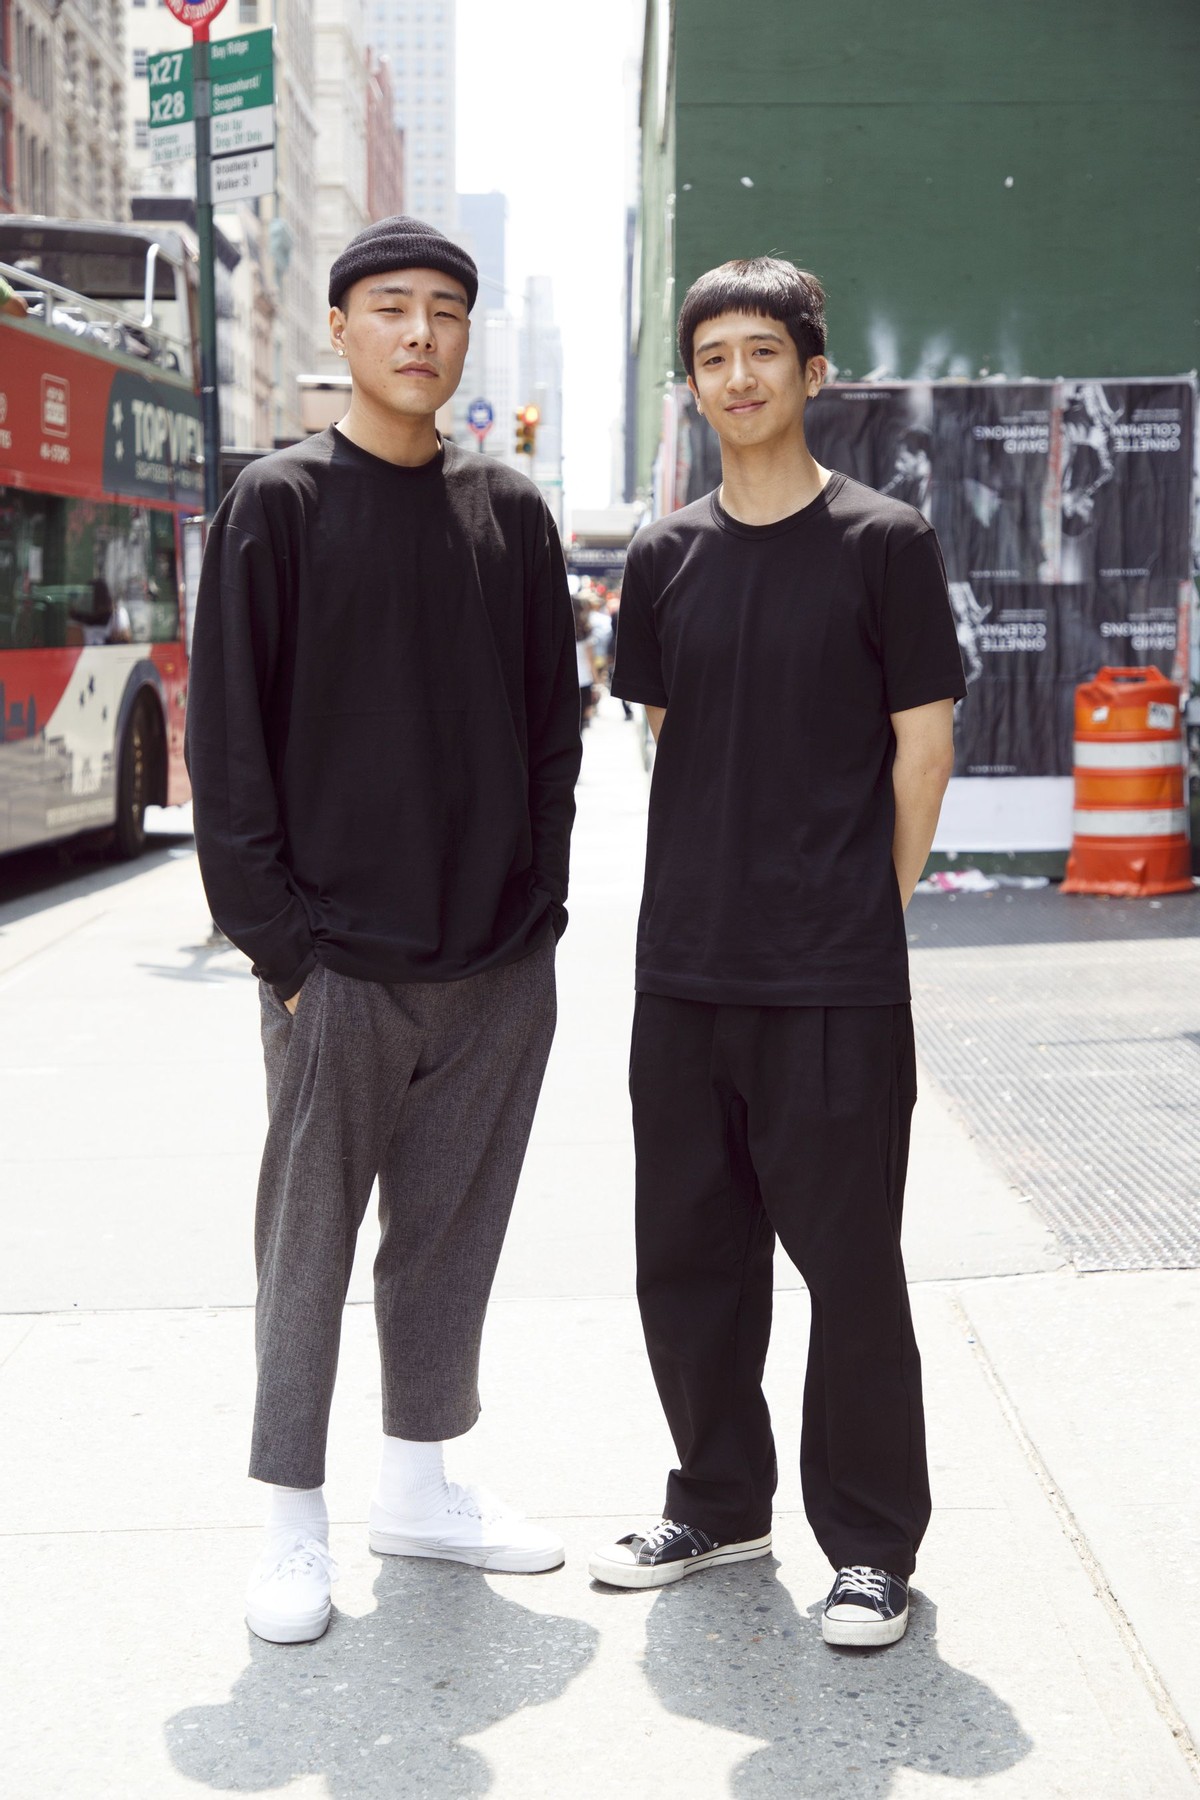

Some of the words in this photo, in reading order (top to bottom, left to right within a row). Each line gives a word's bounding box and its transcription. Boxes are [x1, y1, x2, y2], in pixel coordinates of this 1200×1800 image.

[211, 44, 226, 60] Bay
[227, 40, 249, 57] Ridge
[150, 53, 183, 87] x27
[151, 90, 185, 123] x28
[973, 425, 1049, 440] HAMMONS
[1110, 423, 1181, 438] COLEMAN
[1003, 439, 1050, 454] DAVID
[1115, 437, 1181, 452] ORNETTE
[978, 623, 1047, 638] COLEMAN
[1100, 621, 1177, 637] HAMMONS
[981, 637, 1047, 652] ORNETTE
[1131, 636, 1177, 651] DAVID
